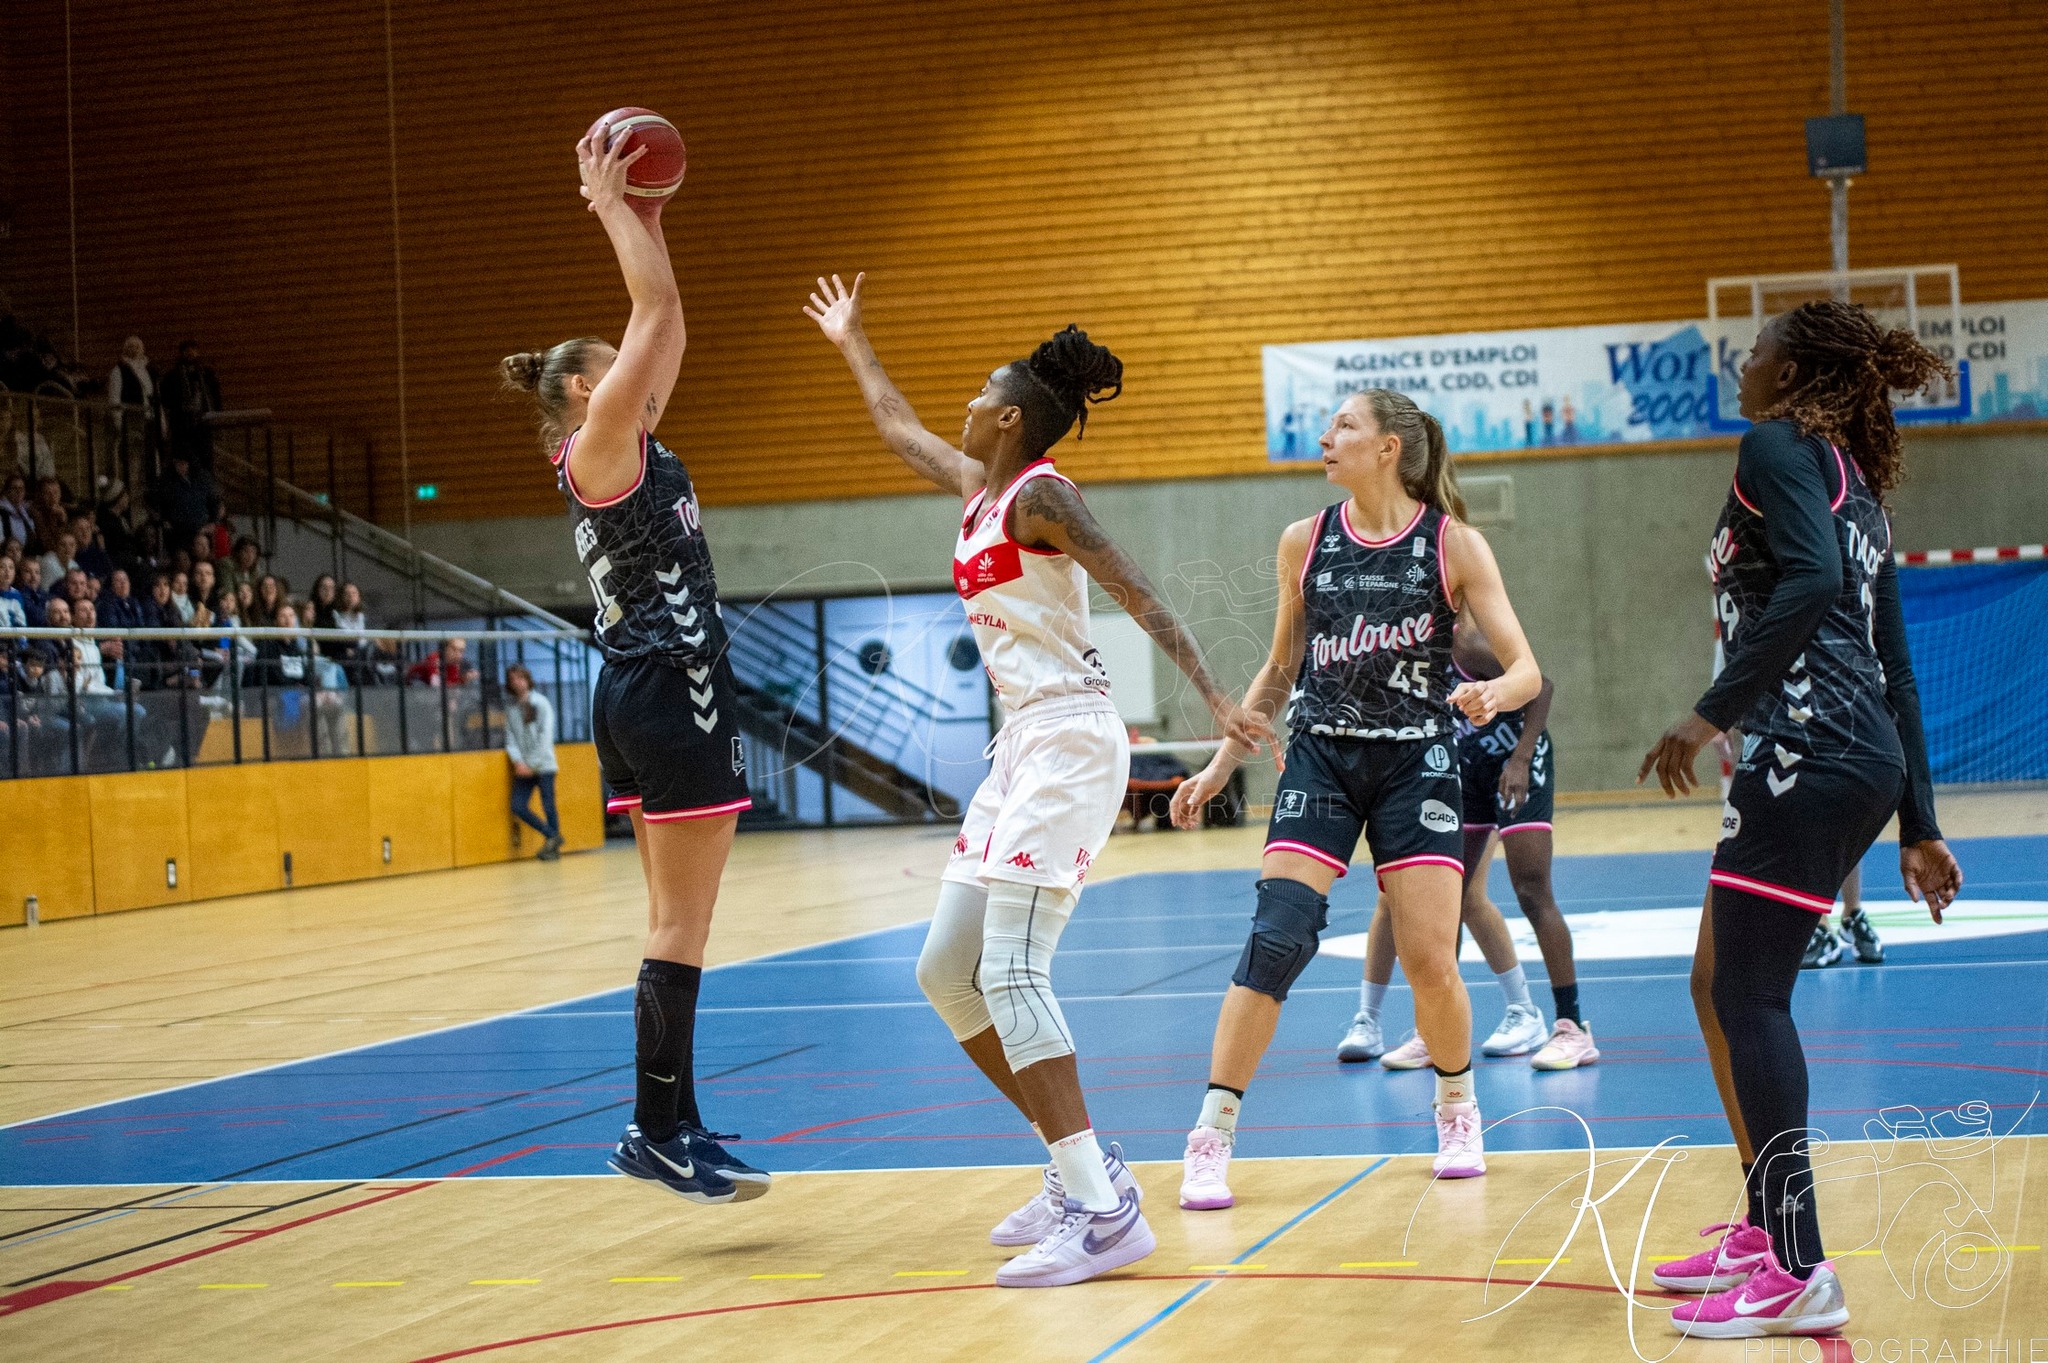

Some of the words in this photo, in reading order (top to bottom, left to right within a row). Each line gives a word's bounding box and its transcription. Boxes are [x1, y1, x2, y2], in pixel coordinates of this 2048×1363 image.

[1335, 350, 1424, 372] AGENCE
[1429, 344, 1539, 367] D'EMPLOI
[1966, 340, 2006, 361] CDI
[1440, 370, 1494, 391] CDD,
[1499, 369, 1539, 388] CDI
[1627, 390, 1709, 425] 2000
[1359, 574, 1385, 582] CAISSE
[1311, 612, 1435, 674] Toulouse
[1387, 660, 1431, 699] 45
[1478, 721, 1519, 756] 20
[1424, 811, 1457, 825] ICADE
